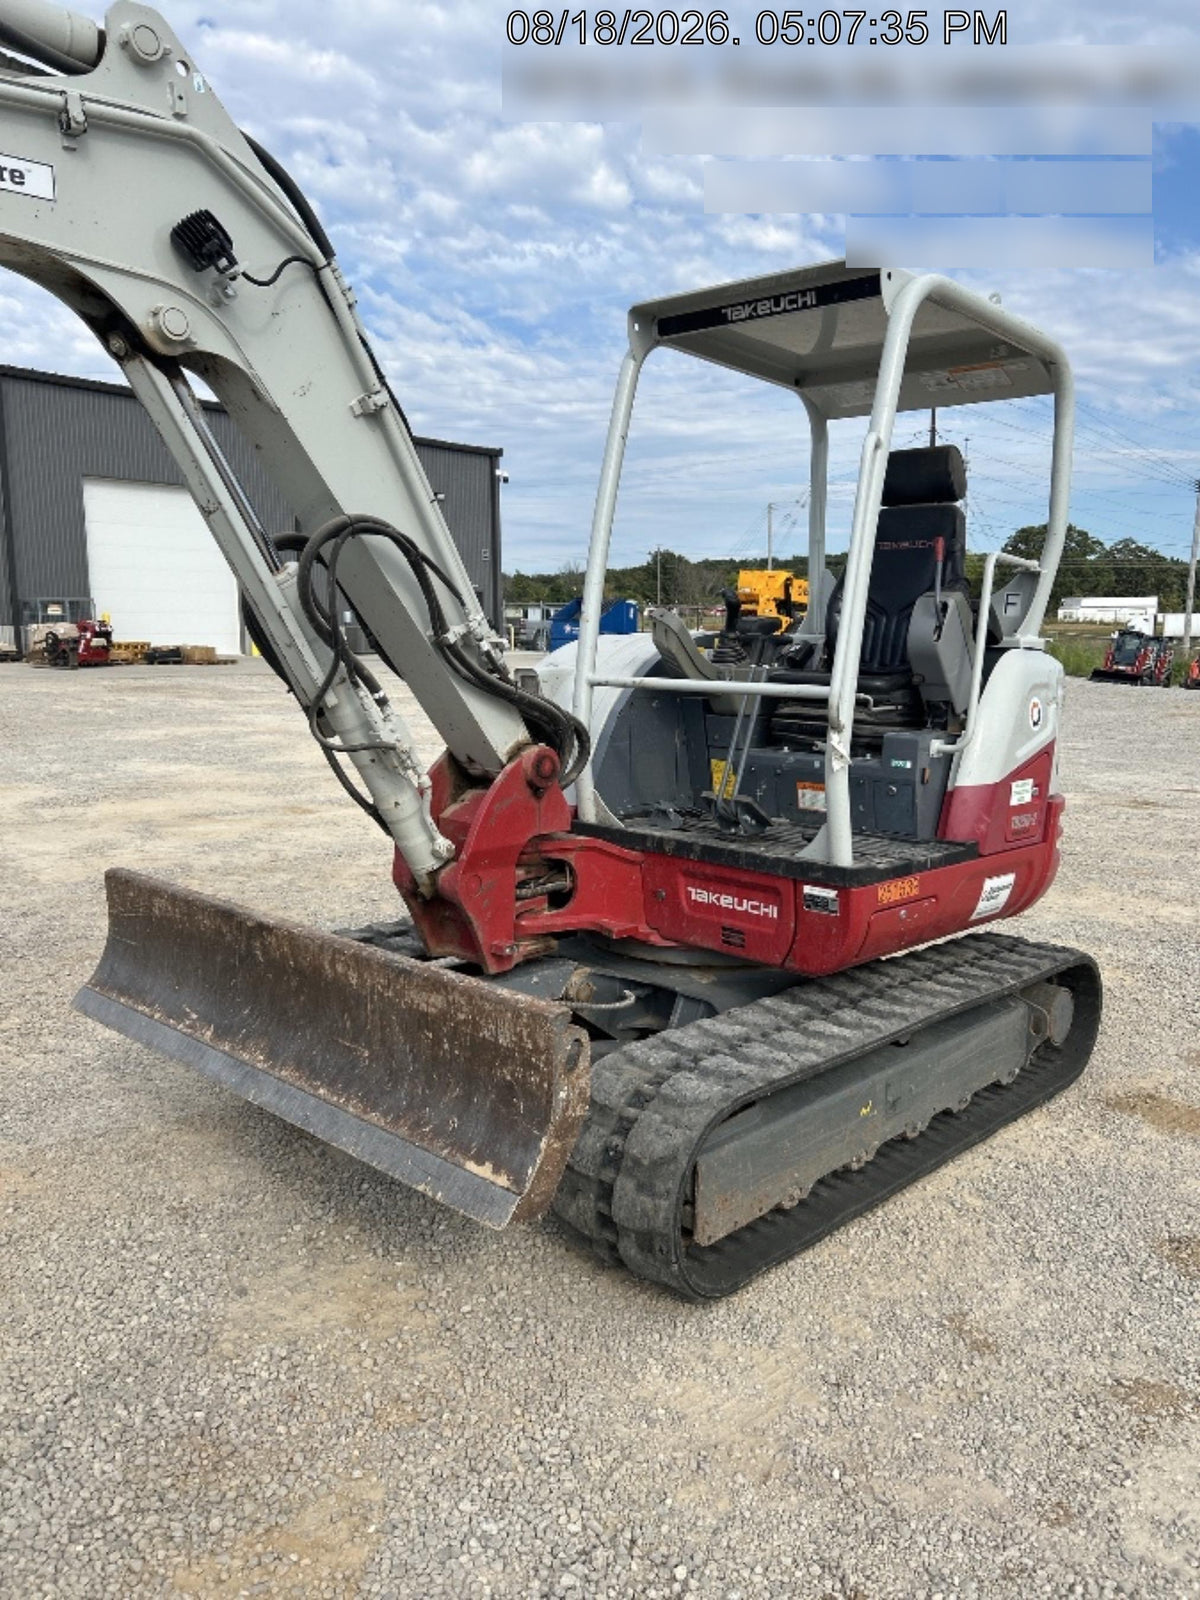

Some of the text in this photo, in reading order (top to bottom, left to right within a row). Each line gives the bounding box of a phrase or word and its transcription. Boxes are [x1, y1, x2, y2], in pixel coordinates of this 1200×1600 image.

[721, 290, 817, 321] TAKEUCHI
[877, 540, 935, 550] TAKEUCH
[1004, 593, 1021, 614] F
[686, 886, 778, 919] TAKEUCHI
